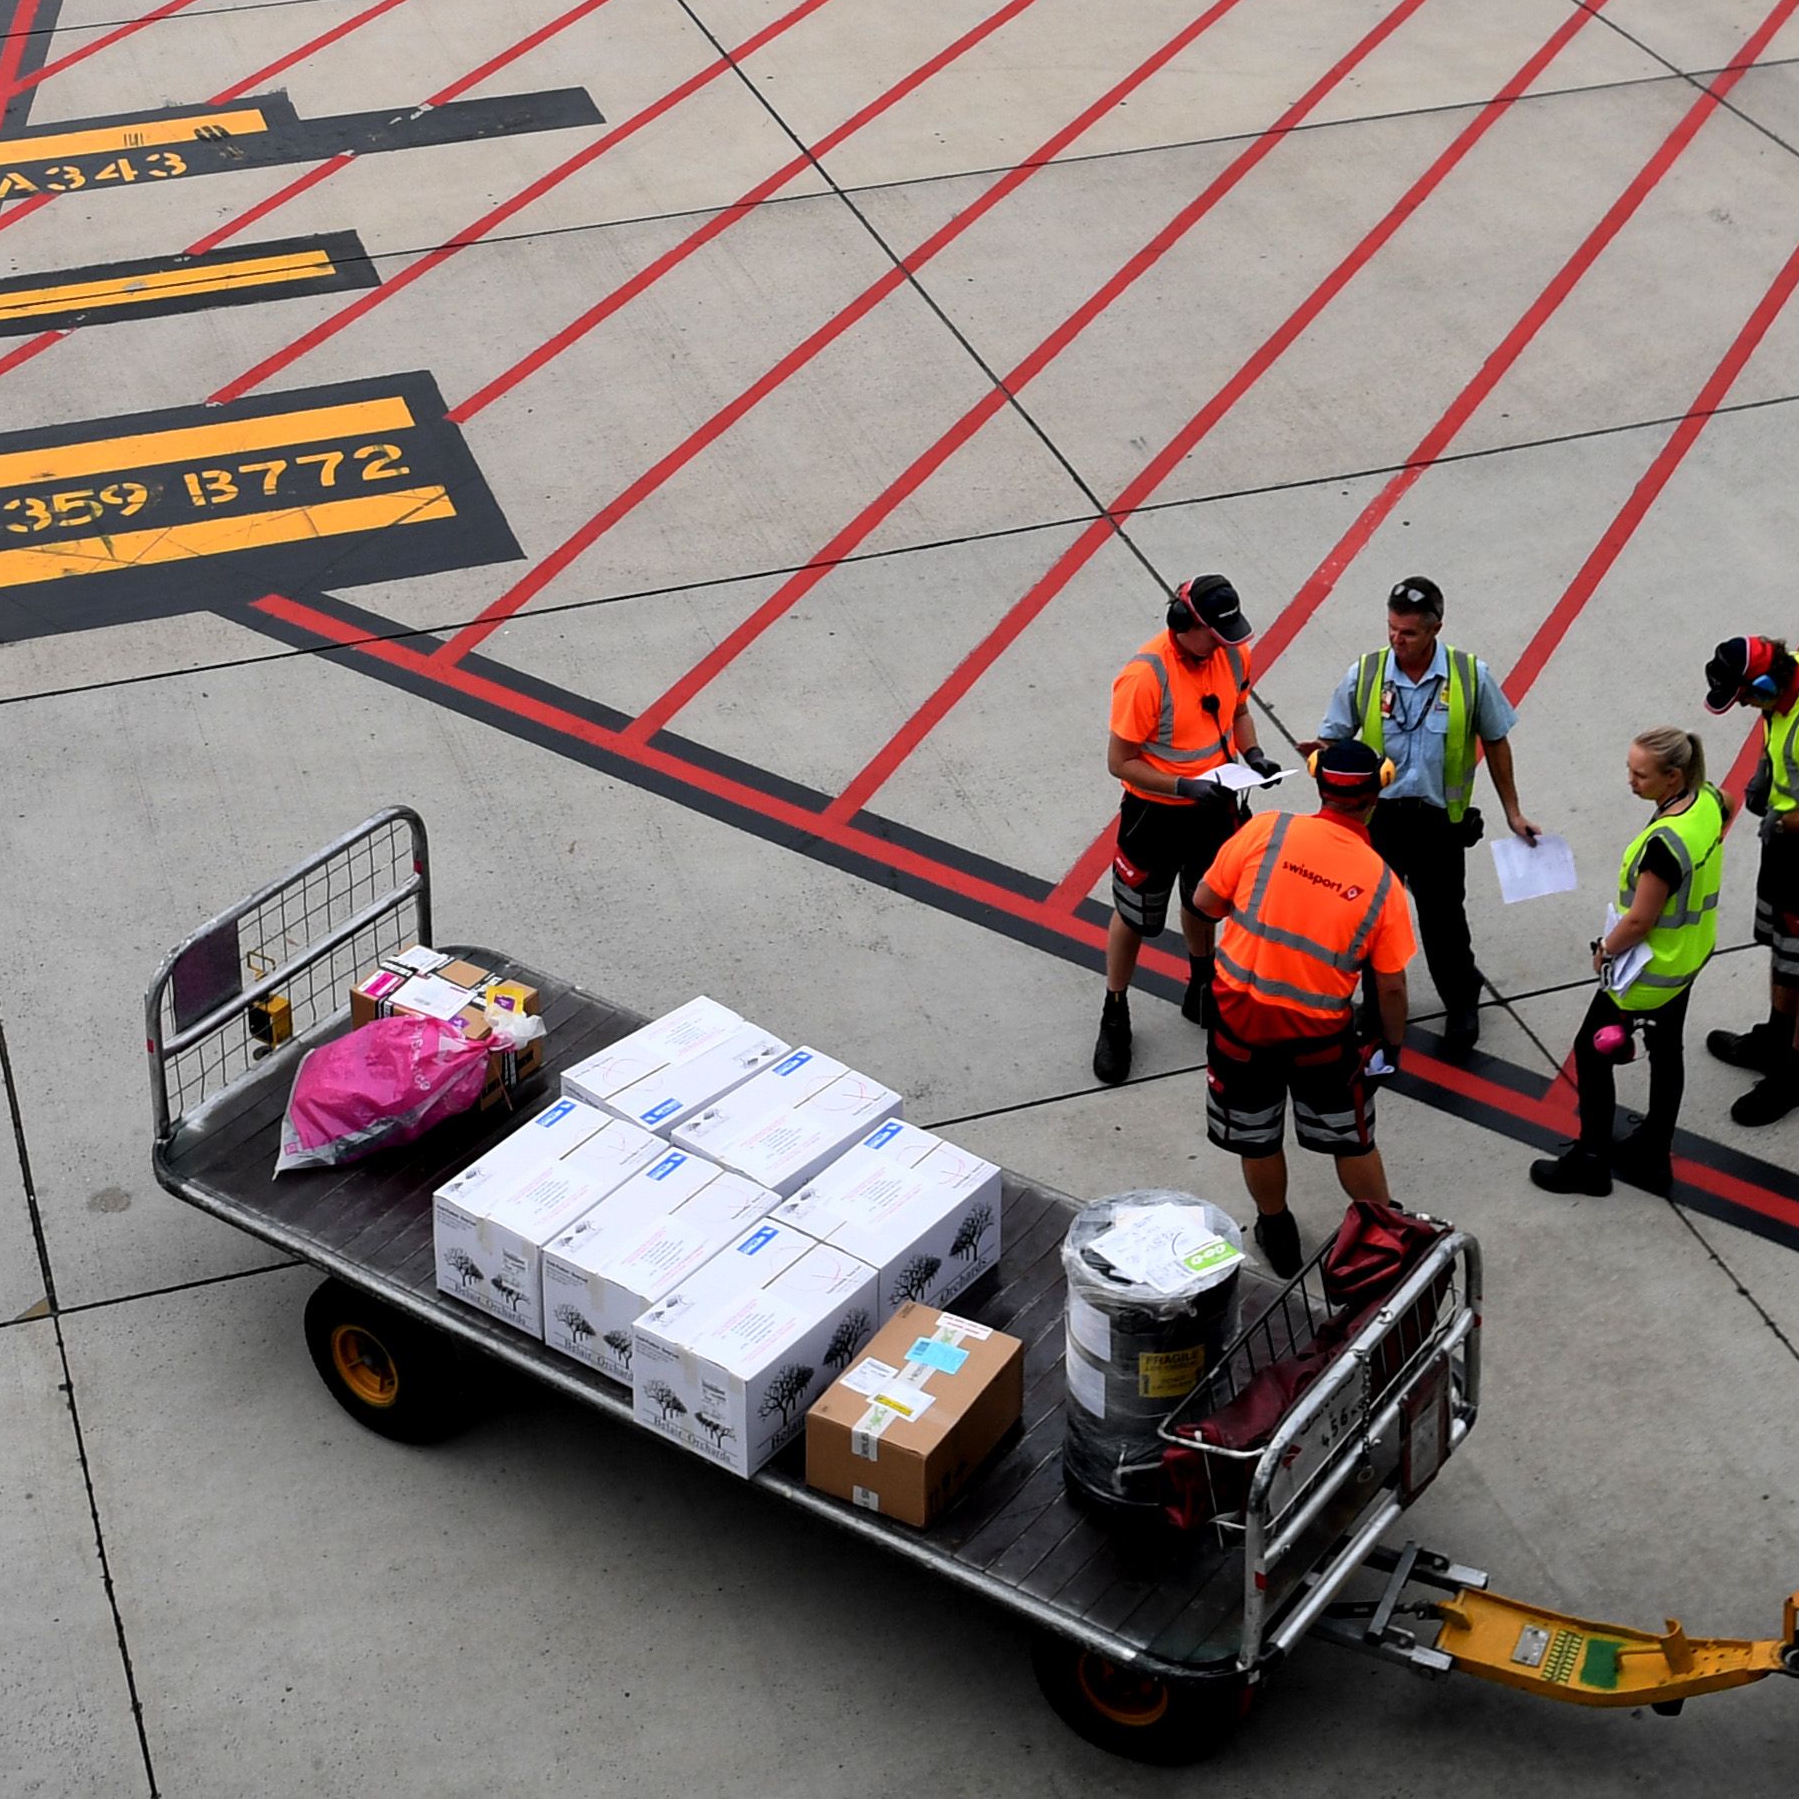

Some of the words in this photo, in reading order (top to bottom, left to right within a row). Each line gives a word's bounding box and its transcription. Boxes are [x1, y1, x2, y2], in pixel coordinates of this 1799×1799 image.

[183, 444, 410, 507] B772
[1282, 859, 1343, 892] swissport
[597, 1355, 634, 1383] Orchard
[654, 1416, 684, 1441] Belair
